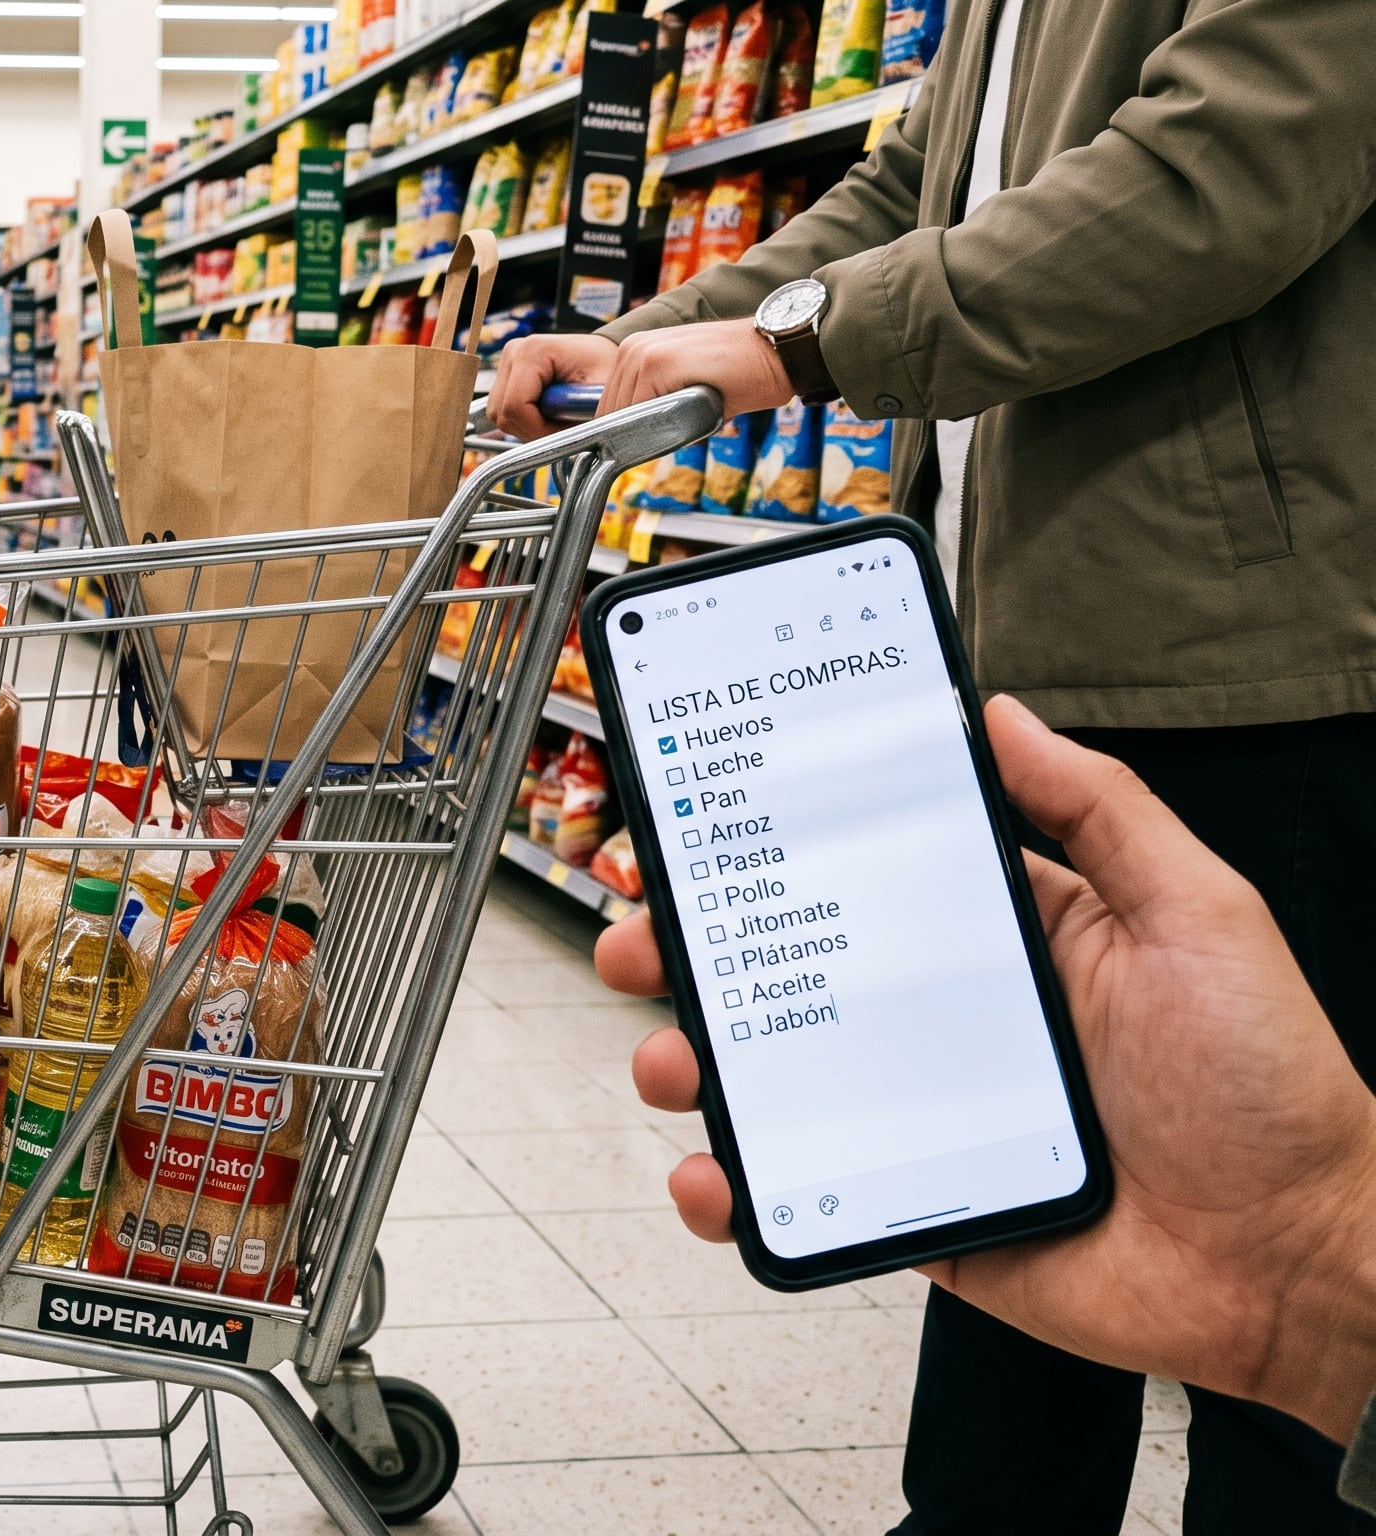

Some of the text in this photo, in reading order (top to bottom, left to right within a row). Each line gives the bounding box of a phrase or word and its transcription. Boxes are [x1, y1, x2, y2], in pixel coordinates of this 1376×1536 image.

[655, 608, 679, 621] 2:00
[648, 647, 908, 723] LISTA DE COMPRAS:
[684, 716, 774, 750] Huevos
[692, 751, 764, 781] Leche
[700, 788, 747, 812] Pan
[710, 816, 773, 844] Arroz
[716, 846, 785, 875] Pasta
[725, 878, 785, 907] Pollo
[734, 901, 841, 938] Jitomate
[741, 934, 849, 971] Plátanos
[752, 972, 826, 1004] Aceite
[759, 1003, 835, 1036] Jabón
[145, 1068, 284, 1121] BIMBO
[48, 1297, 229, 1350] SUPERAMA
